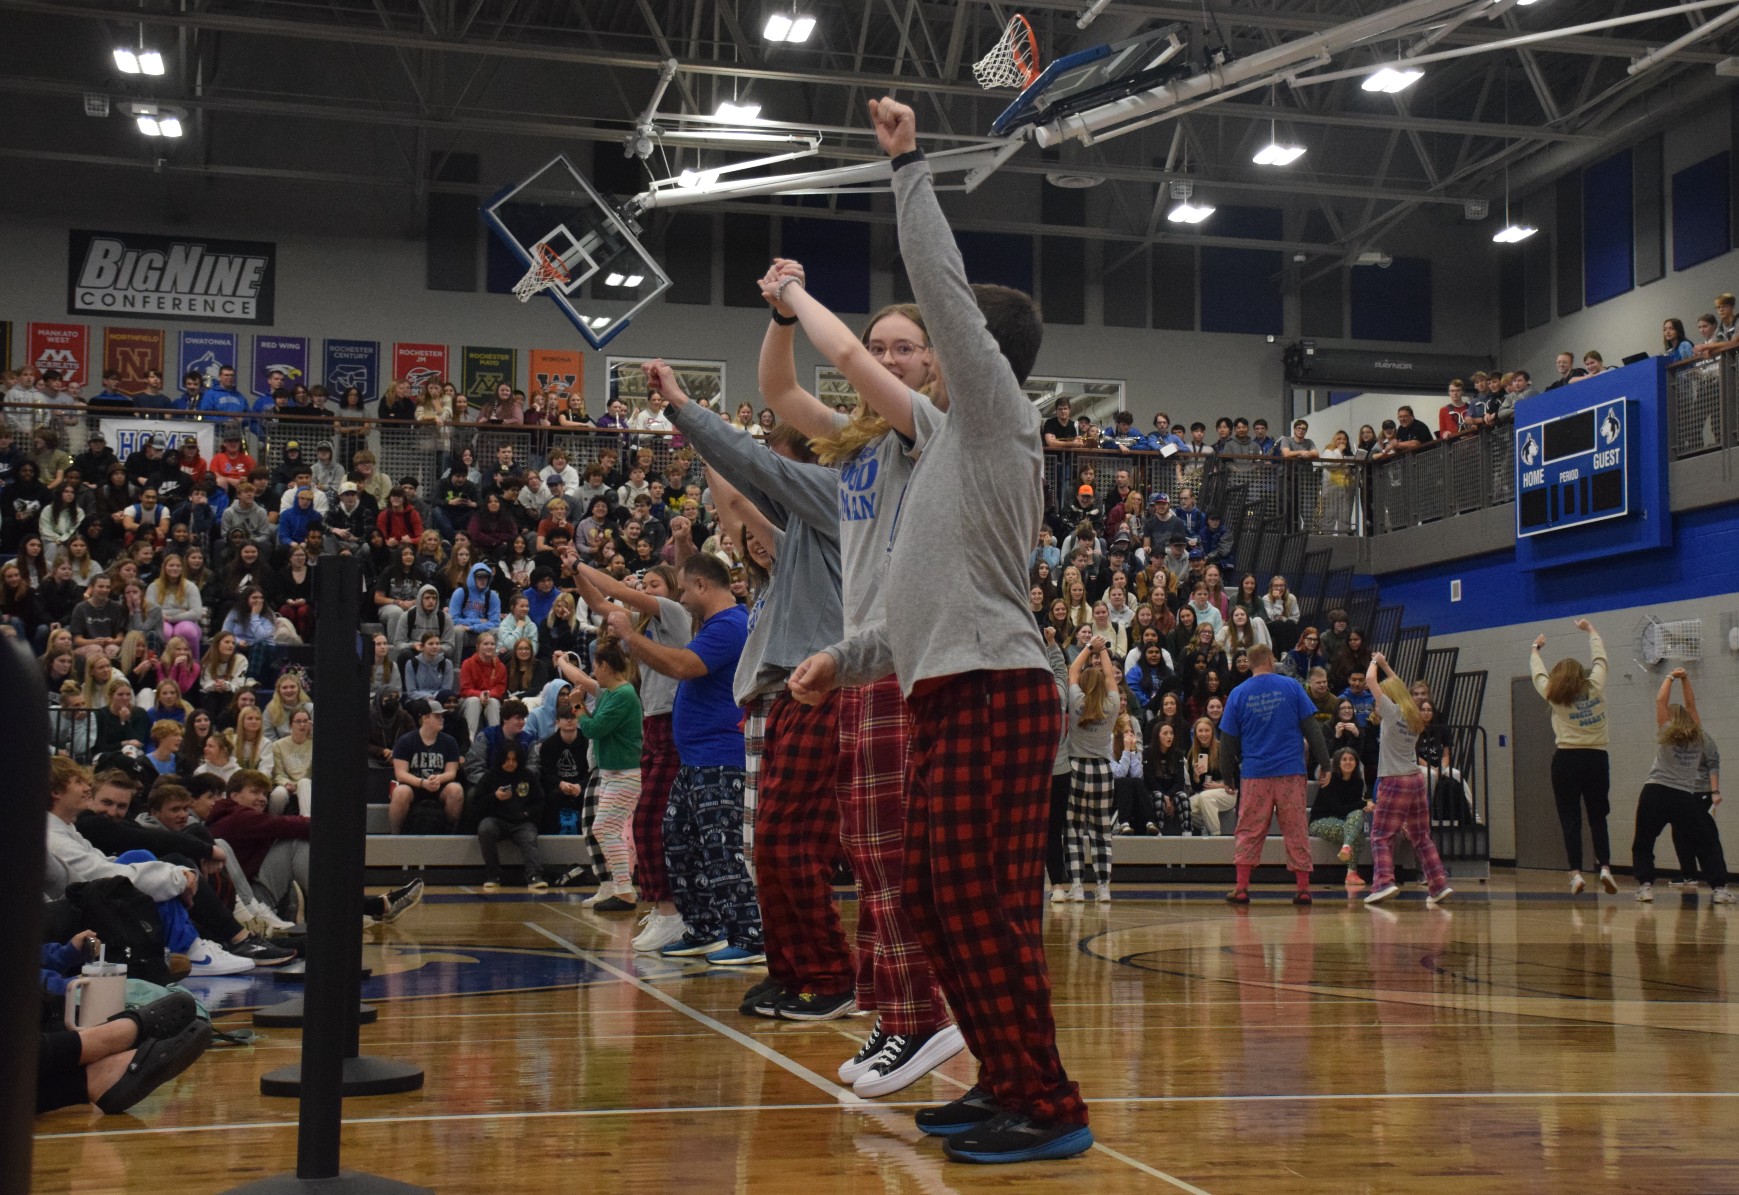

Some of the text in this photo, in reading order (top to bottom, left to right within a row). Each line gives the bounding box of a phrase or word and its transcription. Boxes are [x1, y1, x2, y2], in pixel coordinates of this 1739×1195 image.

[80, 291, 251, 315] CONFERENCE
[37, 329, 79, 338] MANKATO
[109, 332, 160, 343] NORTHFIELD
[46, 336, 71, 344] WEST
[184, 337, 232, 346] OWATONNA
[260, 341, 301, 350] RED WING
[329, 345, 374, 354] ROCHESTER
[333, 352, 369, 360] CENTURY
[398, 348, 443, 358] ROCHESTER
[469, 352, 510, 361] ROCHESTER
[116, 347, 152, 381] N
[479, 359, 500, 367] MAYO
[541, 355, 572, 363] WINONA
[35, 360, 80, 370] SCARLETS
[1373, 360, 1413, 370] RAYNOR
[1592, 447, 1621, 470] GUEST
[1522, 468, 1545, 488] HOME
[1558, 468, 1579, 484] PERIOD
[839, 487, 876, 521] MAN
[410, 751, 445, 770] AERO
